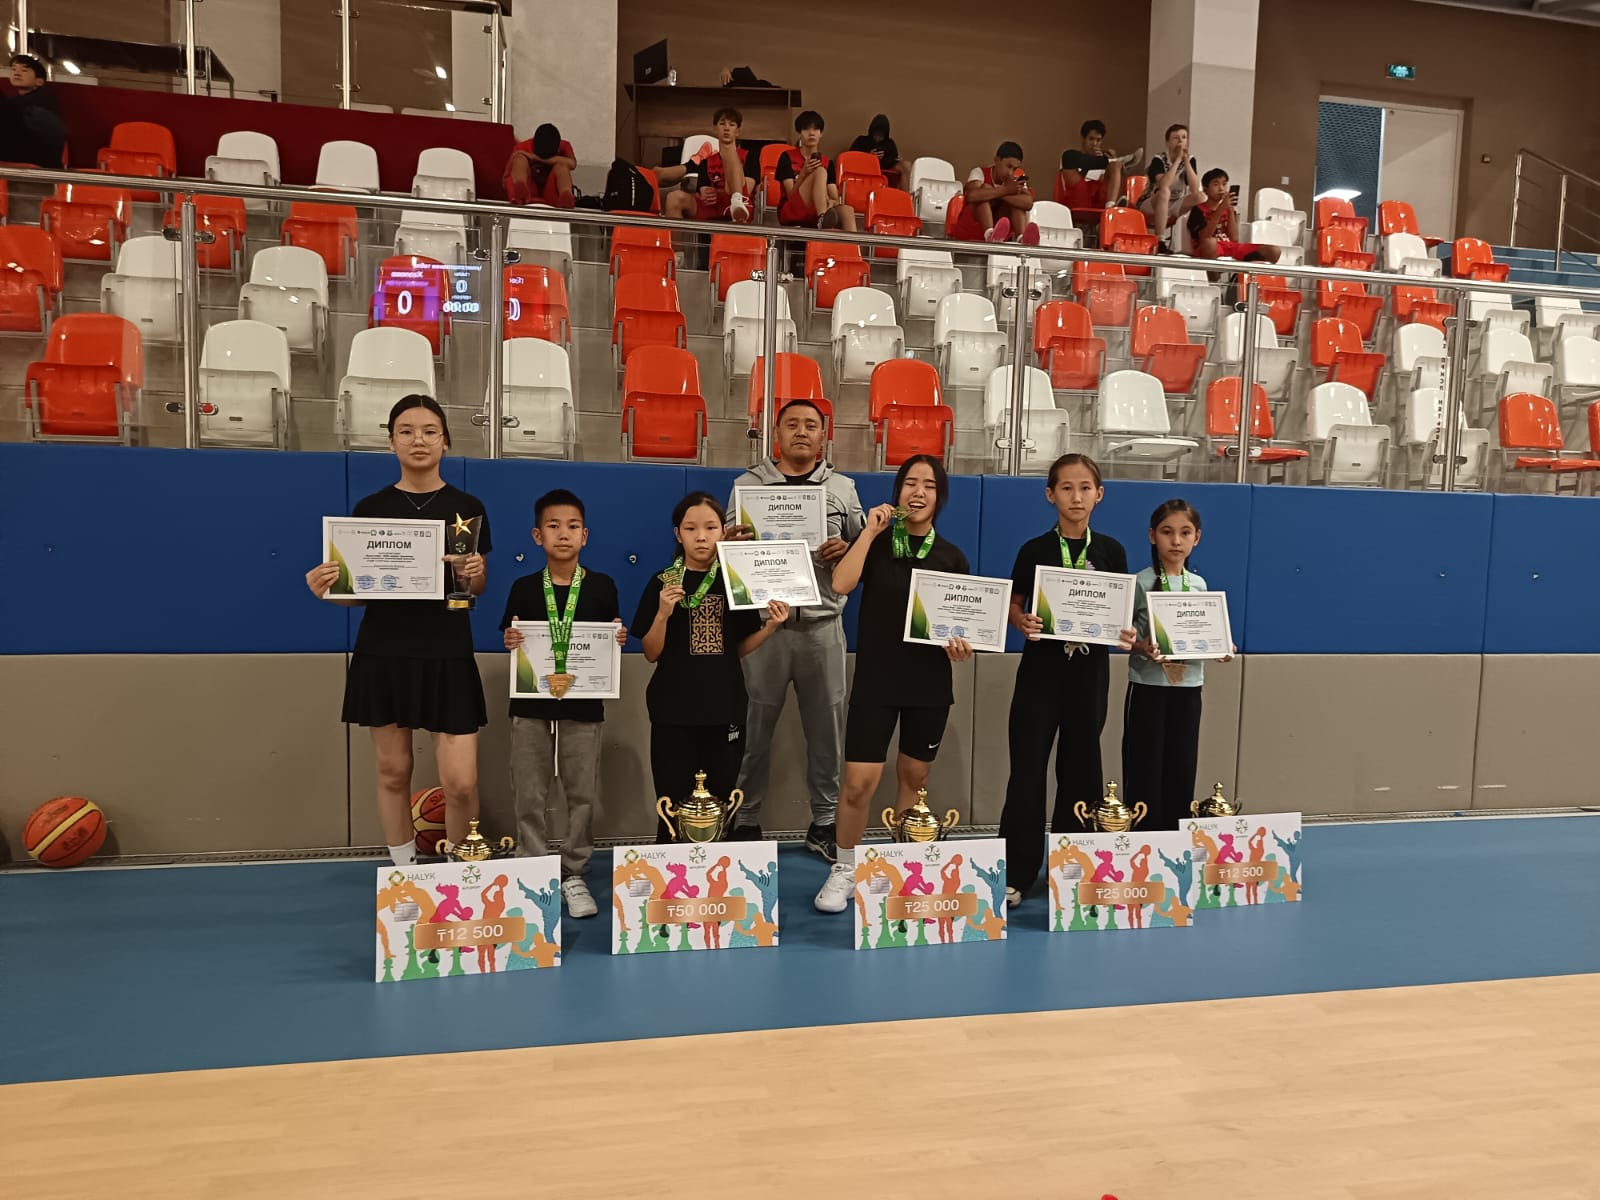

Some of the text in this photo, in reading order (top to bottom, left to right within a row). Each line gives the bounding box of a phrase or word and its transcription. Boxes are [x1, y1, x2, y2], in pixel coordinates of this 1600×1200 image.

[366, 540, 412, 550] ДИПЛОМ
[754, 558, 787, 567] ДИПЛОМ
[944, 593, 982, 604] ДИПЛОМ
[1068, 588, 1106, 599] ДИПЛОМ
[1176, 610, 1206, 618] ДИПЛОМ
[1072, 839, 1095, 847] HALYK
[640, 851, 666, 860] HALYK
[880, 849, 904, 858] HALYK
[407, 872, 436, 882] HALYK
[1243, 866, 1264, 878] 500
[1123, 887, 1148, 899] 000
[698, 902, 727, 917] 000
[934, 898, 960, 912] 000
[472, 924, 504, 940] 500
